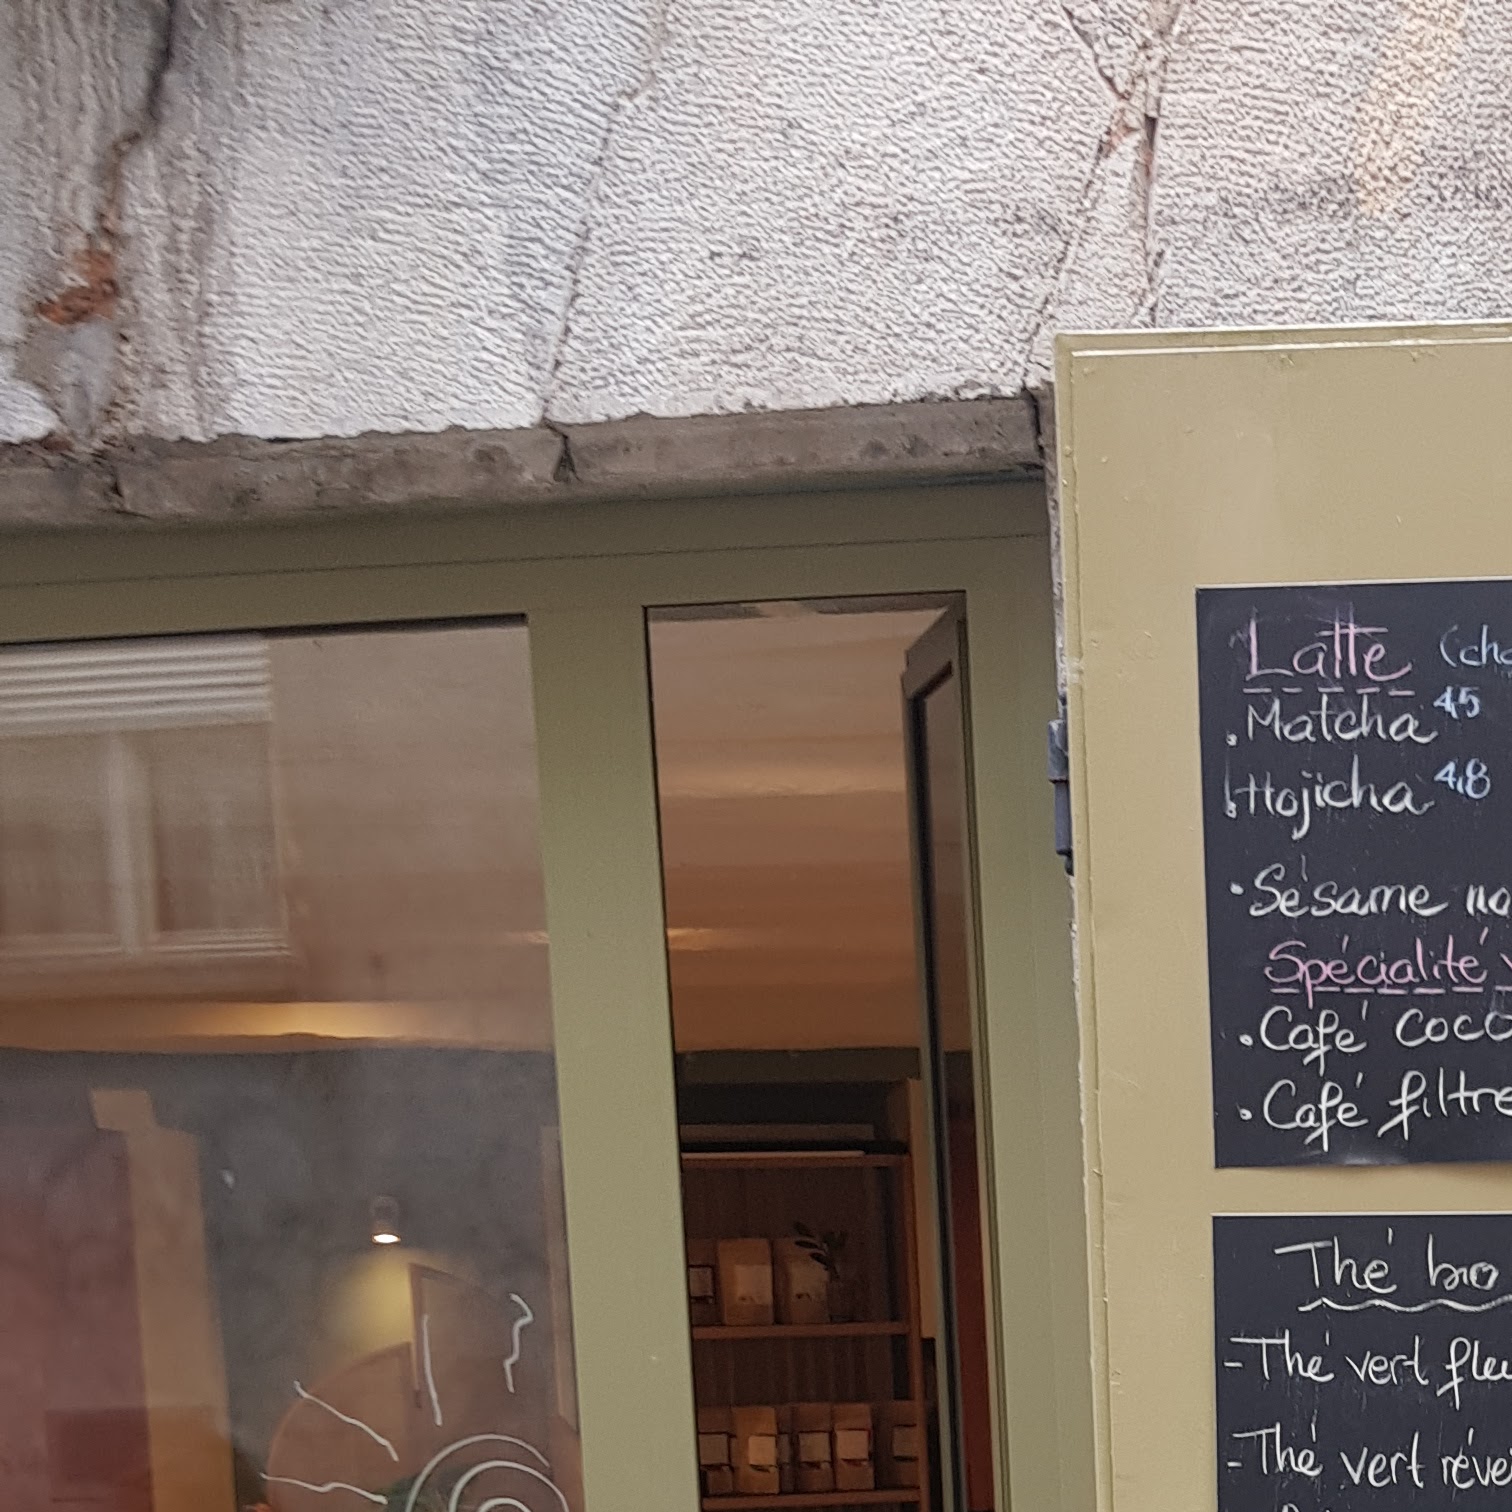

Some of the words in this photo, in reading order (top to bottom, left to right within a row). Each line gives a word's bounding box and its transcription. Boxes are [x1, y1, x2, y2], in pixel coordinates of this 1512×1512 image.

[1246, 612, 1412, 681] Latte
[1248, 694, 1438, 744] Matcha
[1234, 754, 1435, 840] Hojicha
[1249, 856, 1449, 917] Sésame
[1265, 926, 1490, 1008] Spécialité
[1259, 1000, 1369, 1076] Café
[1263, 1072, 1370, 1152] Café
[1274, 1227, 1397, 1293] Thé
[1345, 1335, 1430, 1386] vert
[1341, 1435, 1427, 1487] vert
